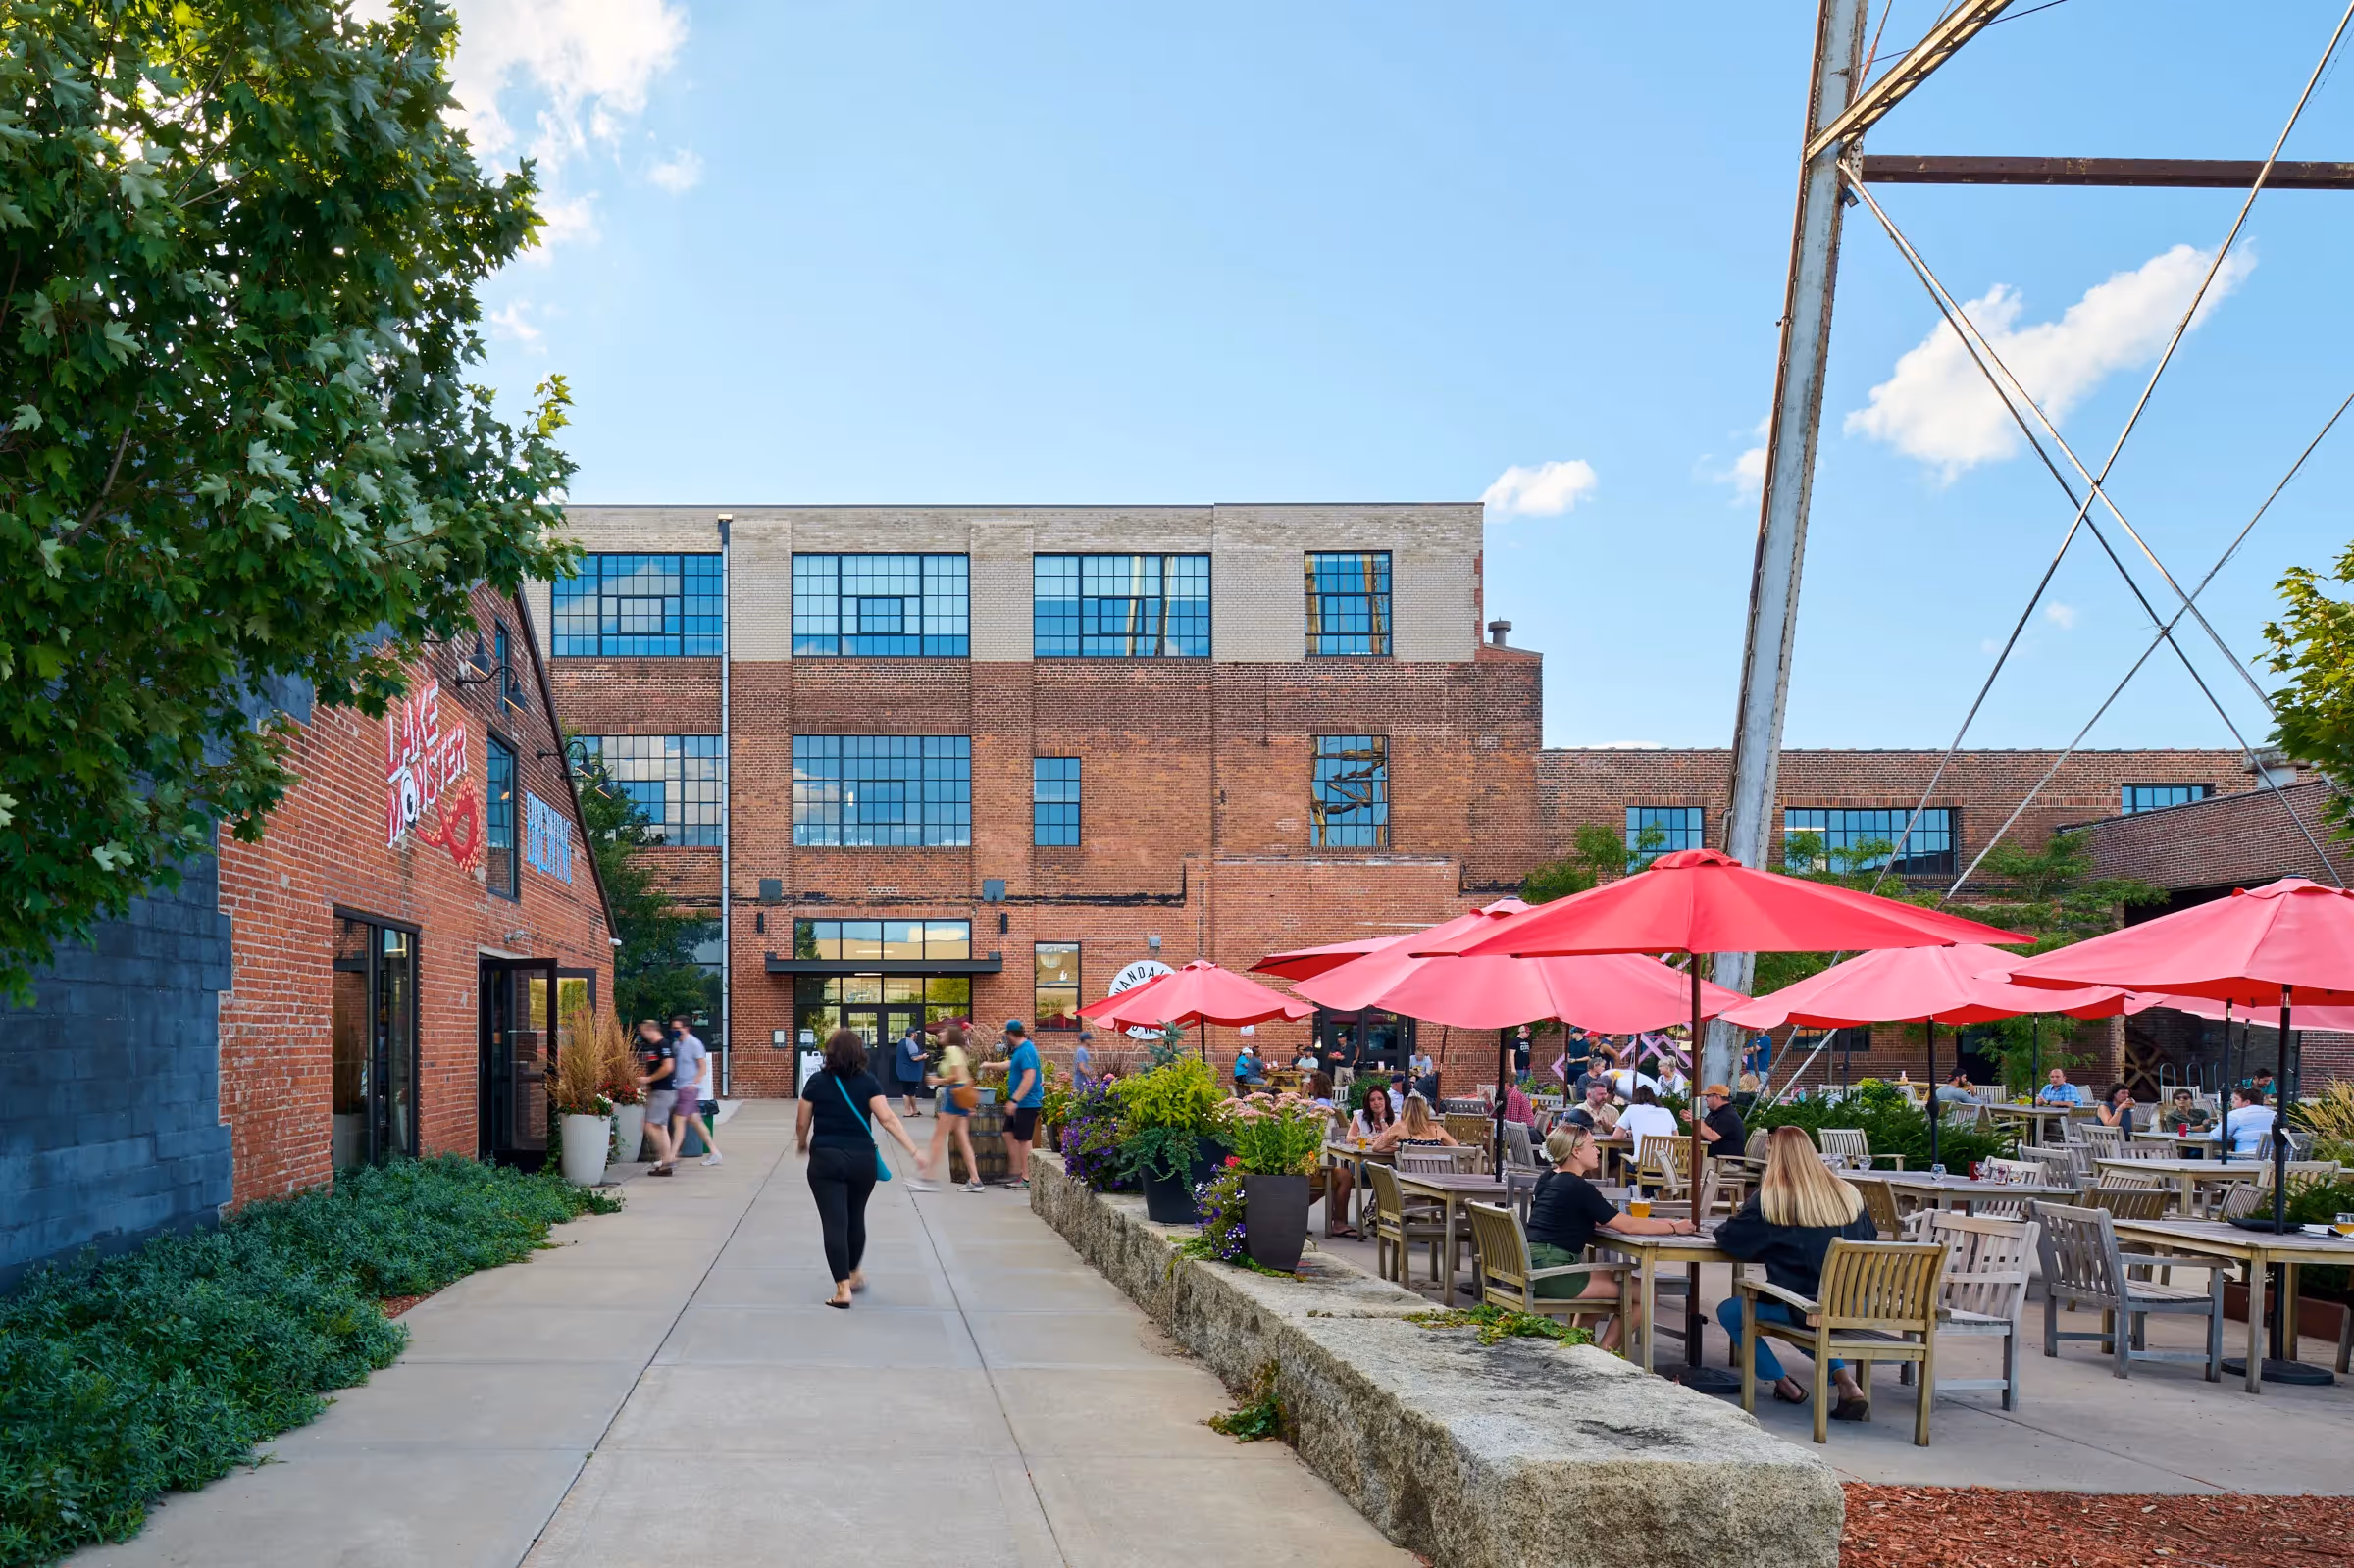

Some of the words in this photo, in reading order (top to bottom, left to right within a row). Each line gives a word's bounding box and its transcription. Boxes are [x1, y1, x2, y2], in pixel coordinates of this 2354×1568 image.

[386, 677, 439, 784] LAKE
[386, 719, 469, 850] MONSTER
[526, 790, 572, 885] BREWING
